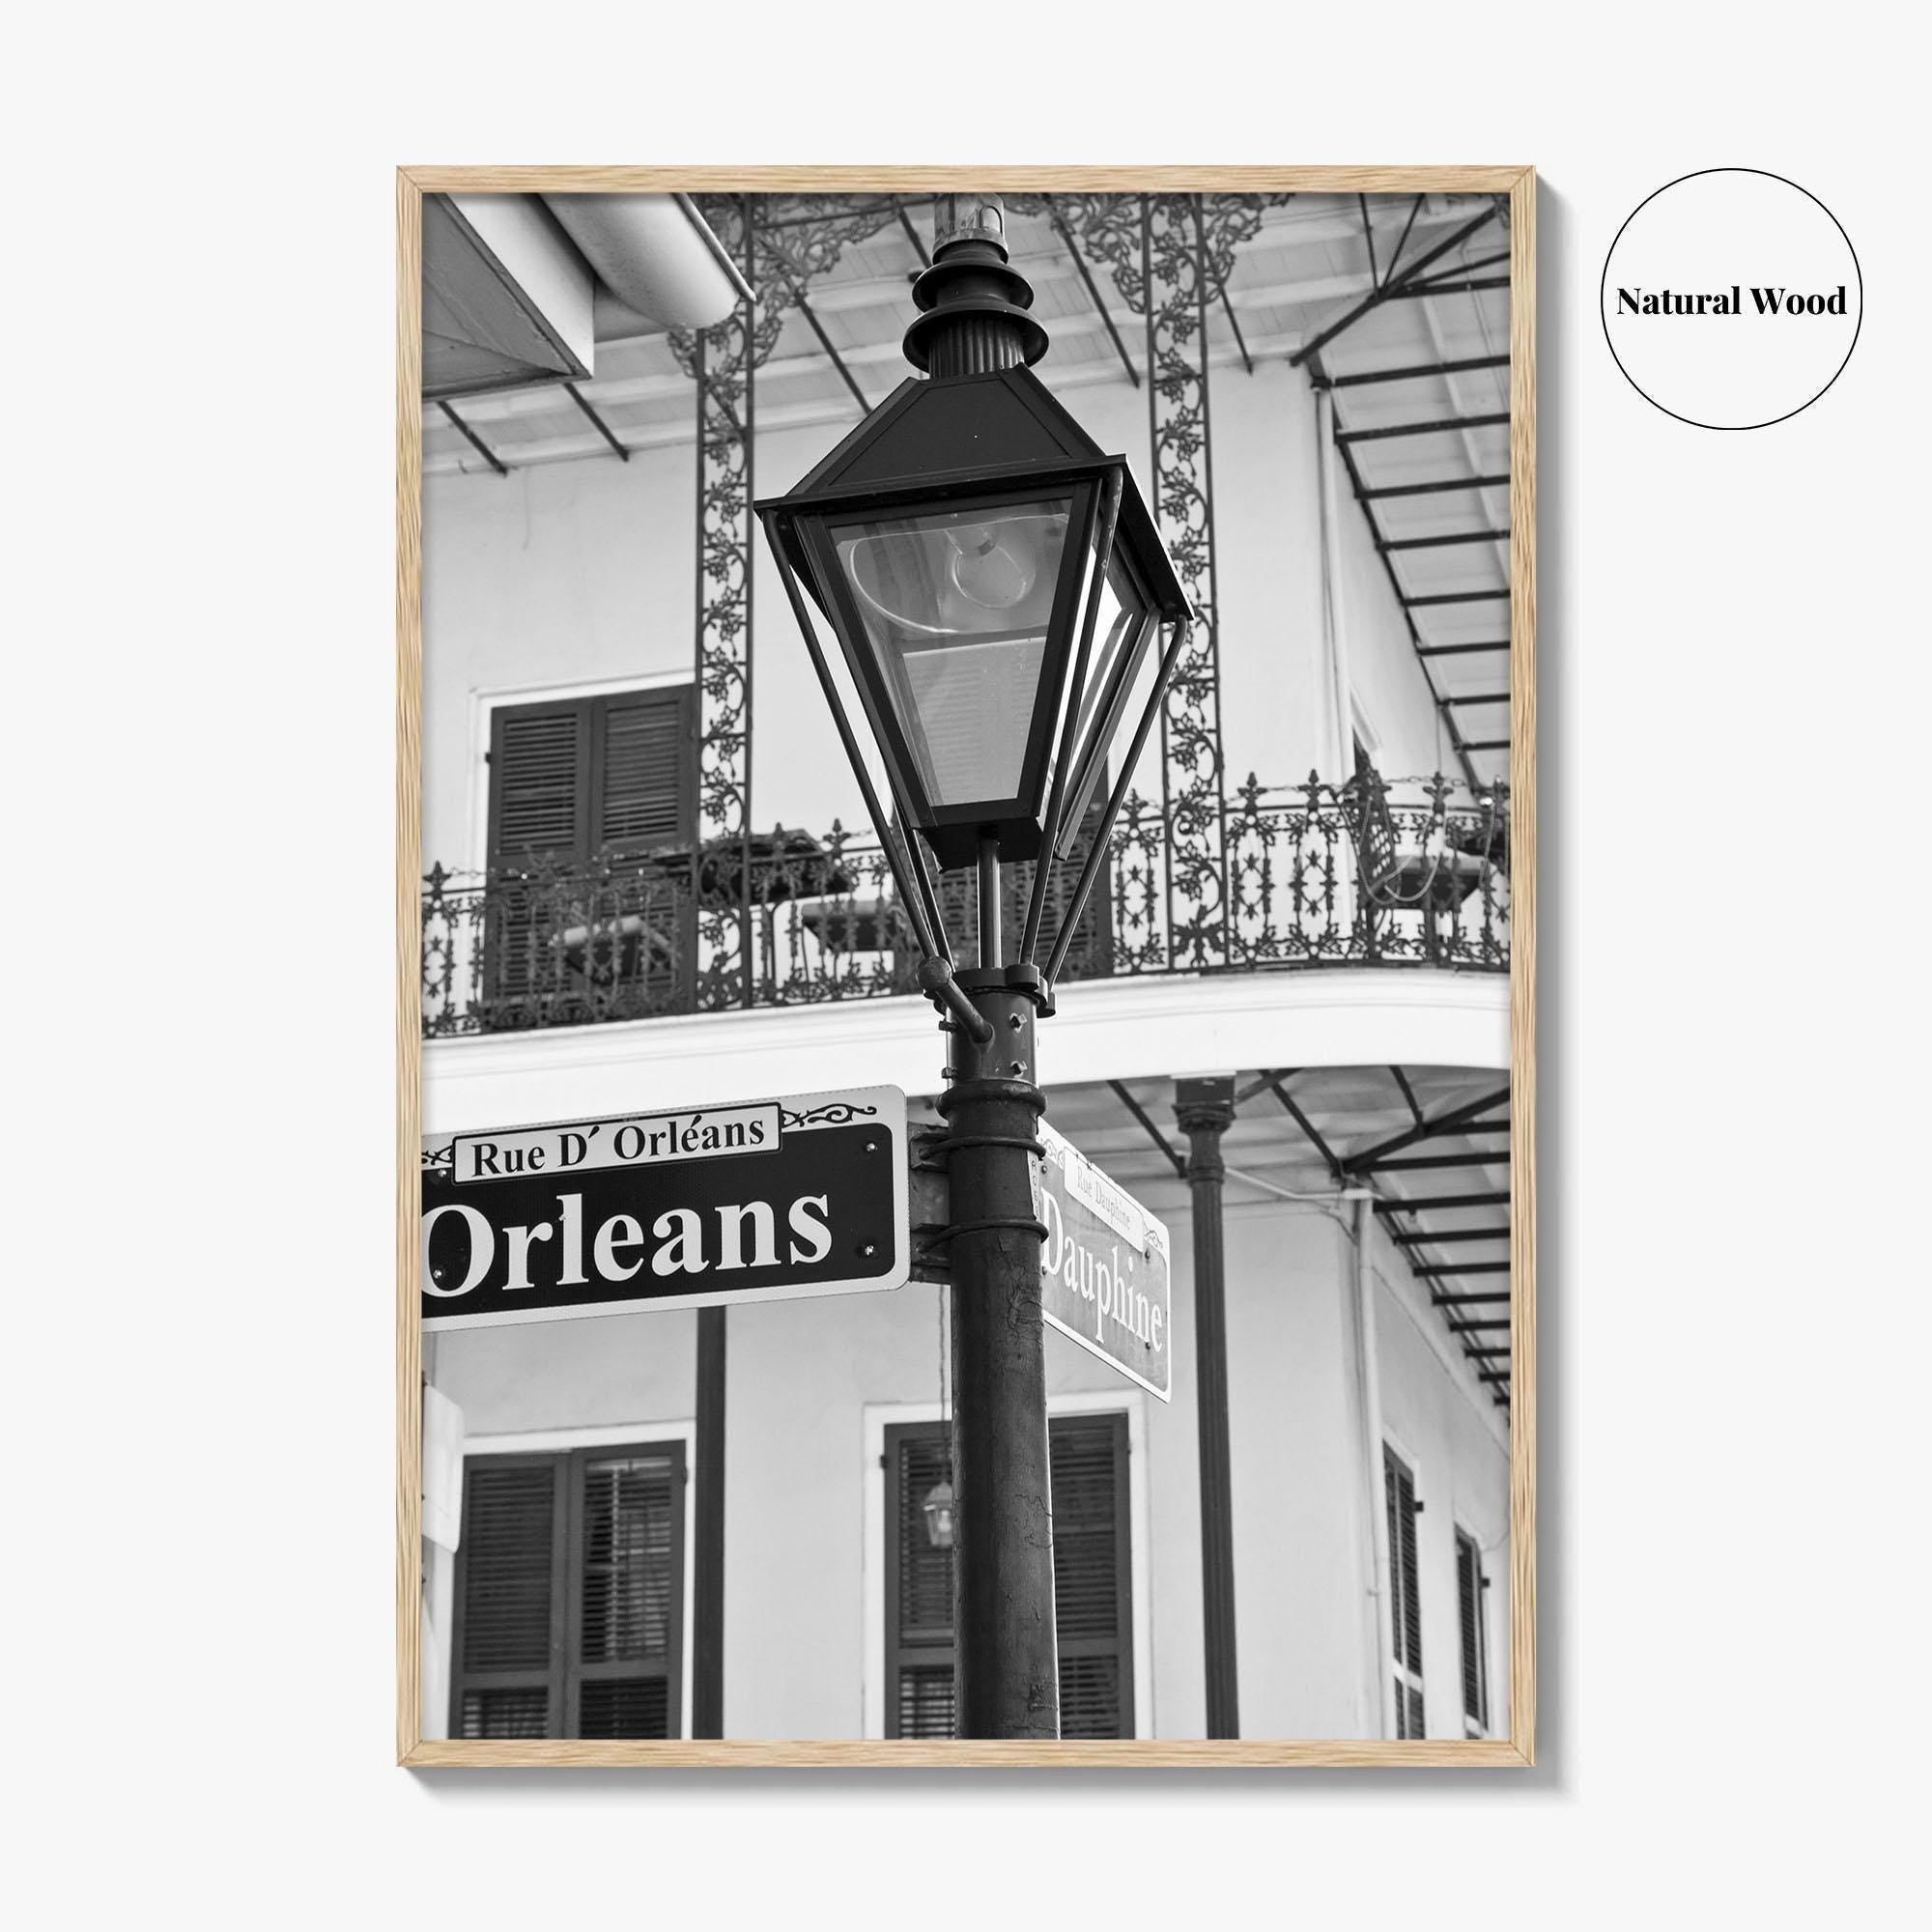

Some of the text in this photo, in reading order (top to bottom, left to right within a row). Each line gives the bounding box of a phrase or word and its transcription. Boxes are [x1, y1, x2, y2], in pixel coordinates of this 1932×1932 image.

[471, 1142, 546, 1178] Rue
[613, 1114, 766, 1161] Orléans
[1077, 1165, 1093, 1198] Rue
[1095, 1180, 1131, 1230] Dauphine
[421, 1193, 834, 1299] Orleans
[1040, 1187, 1163, 1353] Dauphine
